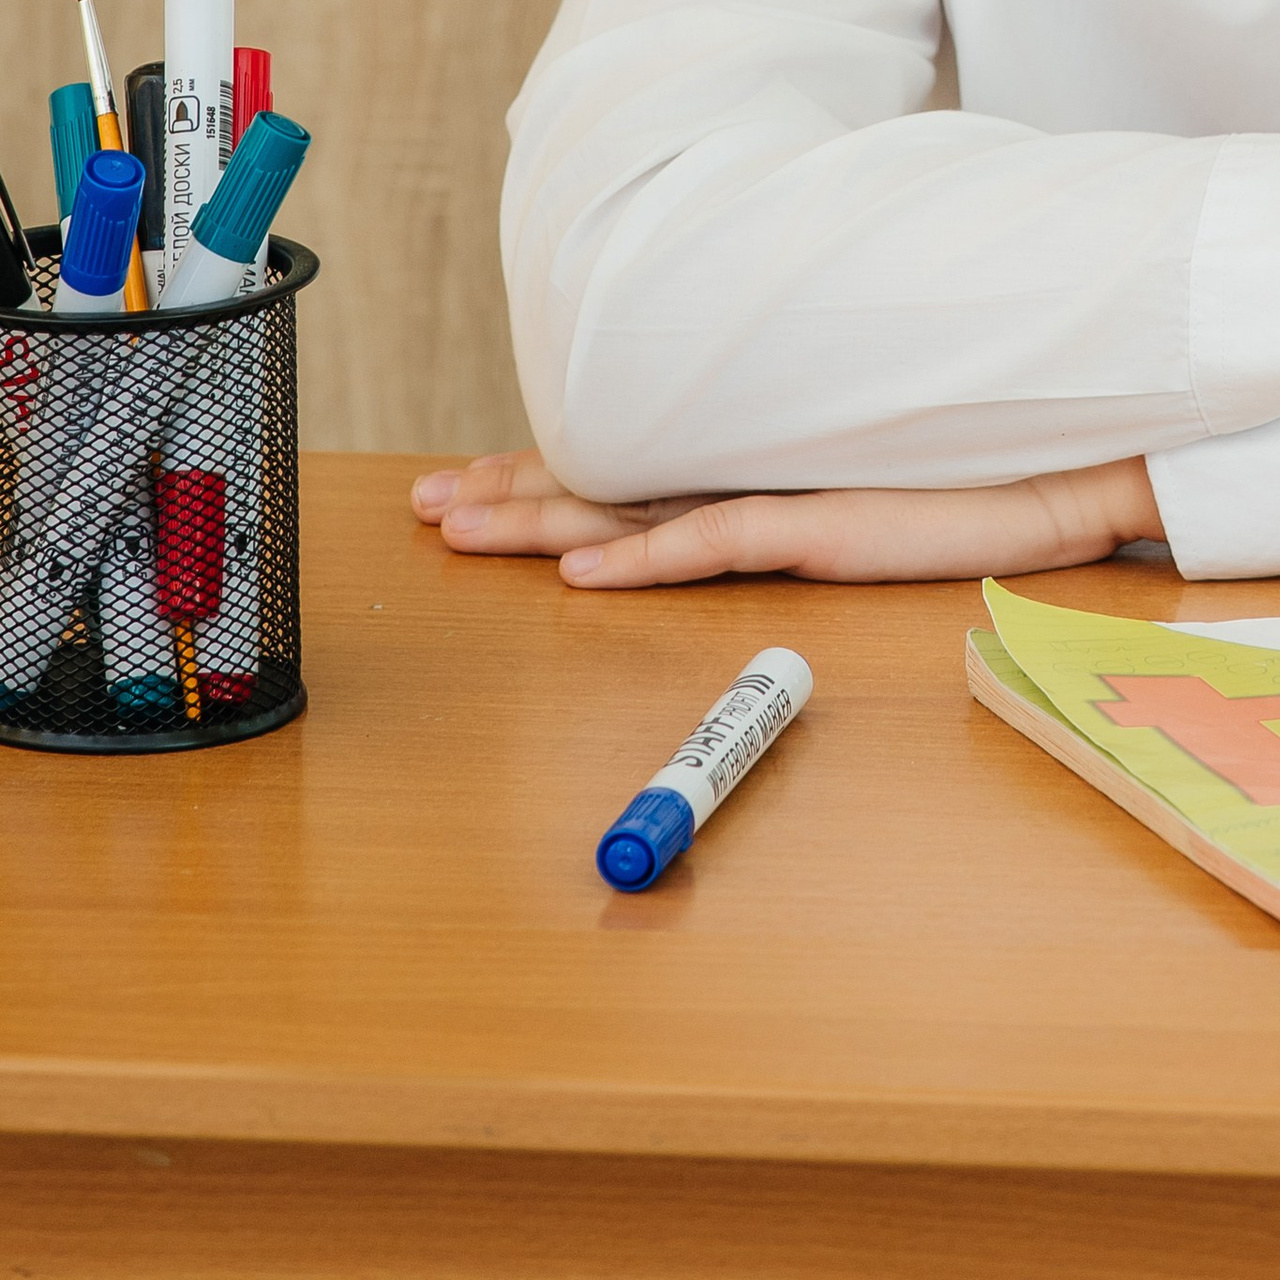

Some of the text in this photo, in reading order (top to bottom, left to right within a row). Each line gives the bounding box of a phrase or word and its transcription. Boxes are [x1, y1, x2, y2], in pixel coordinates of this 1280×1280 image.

[172, 78, 183, 94] 2,5
[206, 106, 216, 140] 151648
[171, 142, 193, 269] ЕЛОЙ ДОСКИ
[661, 690, 760, 768] STAFF PROFIT
[706, 688, 793, 803] WHITEBOARD MARKER
